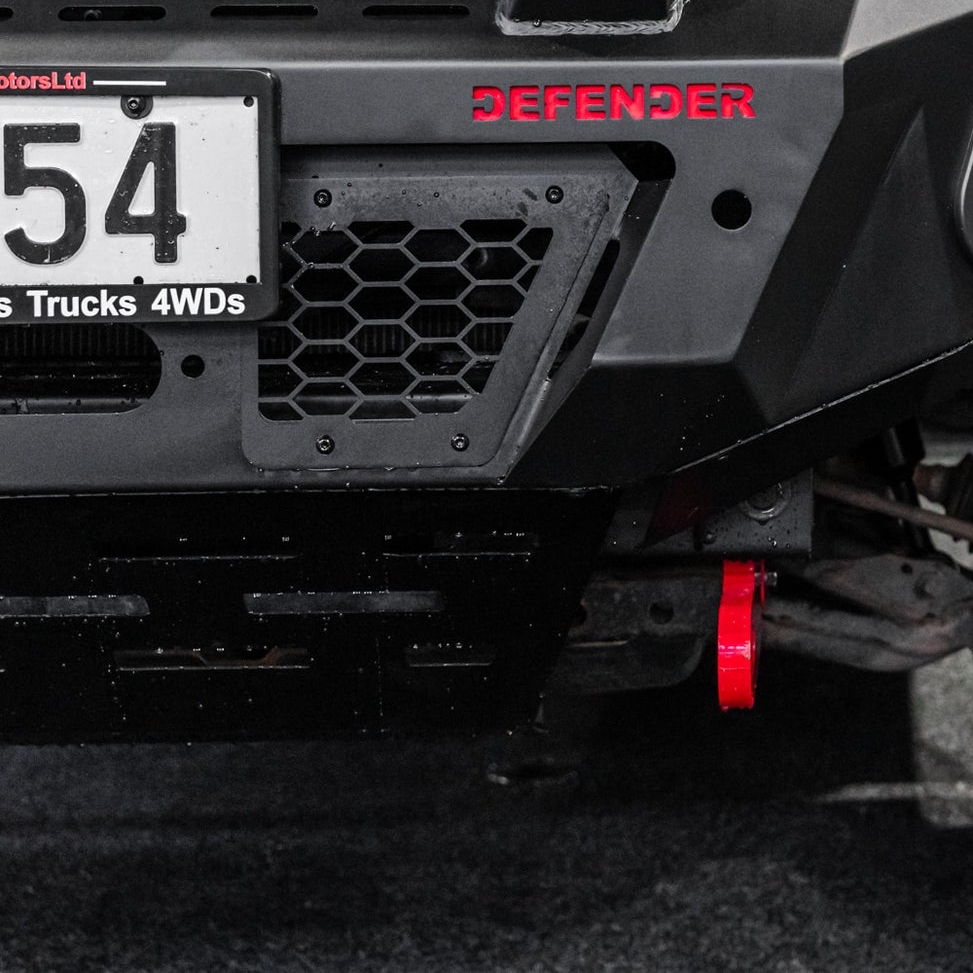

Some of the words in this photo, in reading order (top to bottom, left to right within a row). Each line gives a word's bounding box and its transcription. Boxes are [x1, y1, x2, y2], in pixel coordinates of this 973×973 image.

[472, 83, 756, 122] DEFENDER
[3, 122, 187, 265] 54
[26, 289, 137, 317] Trucks
[151, 287, 246, 316] 4WDs
